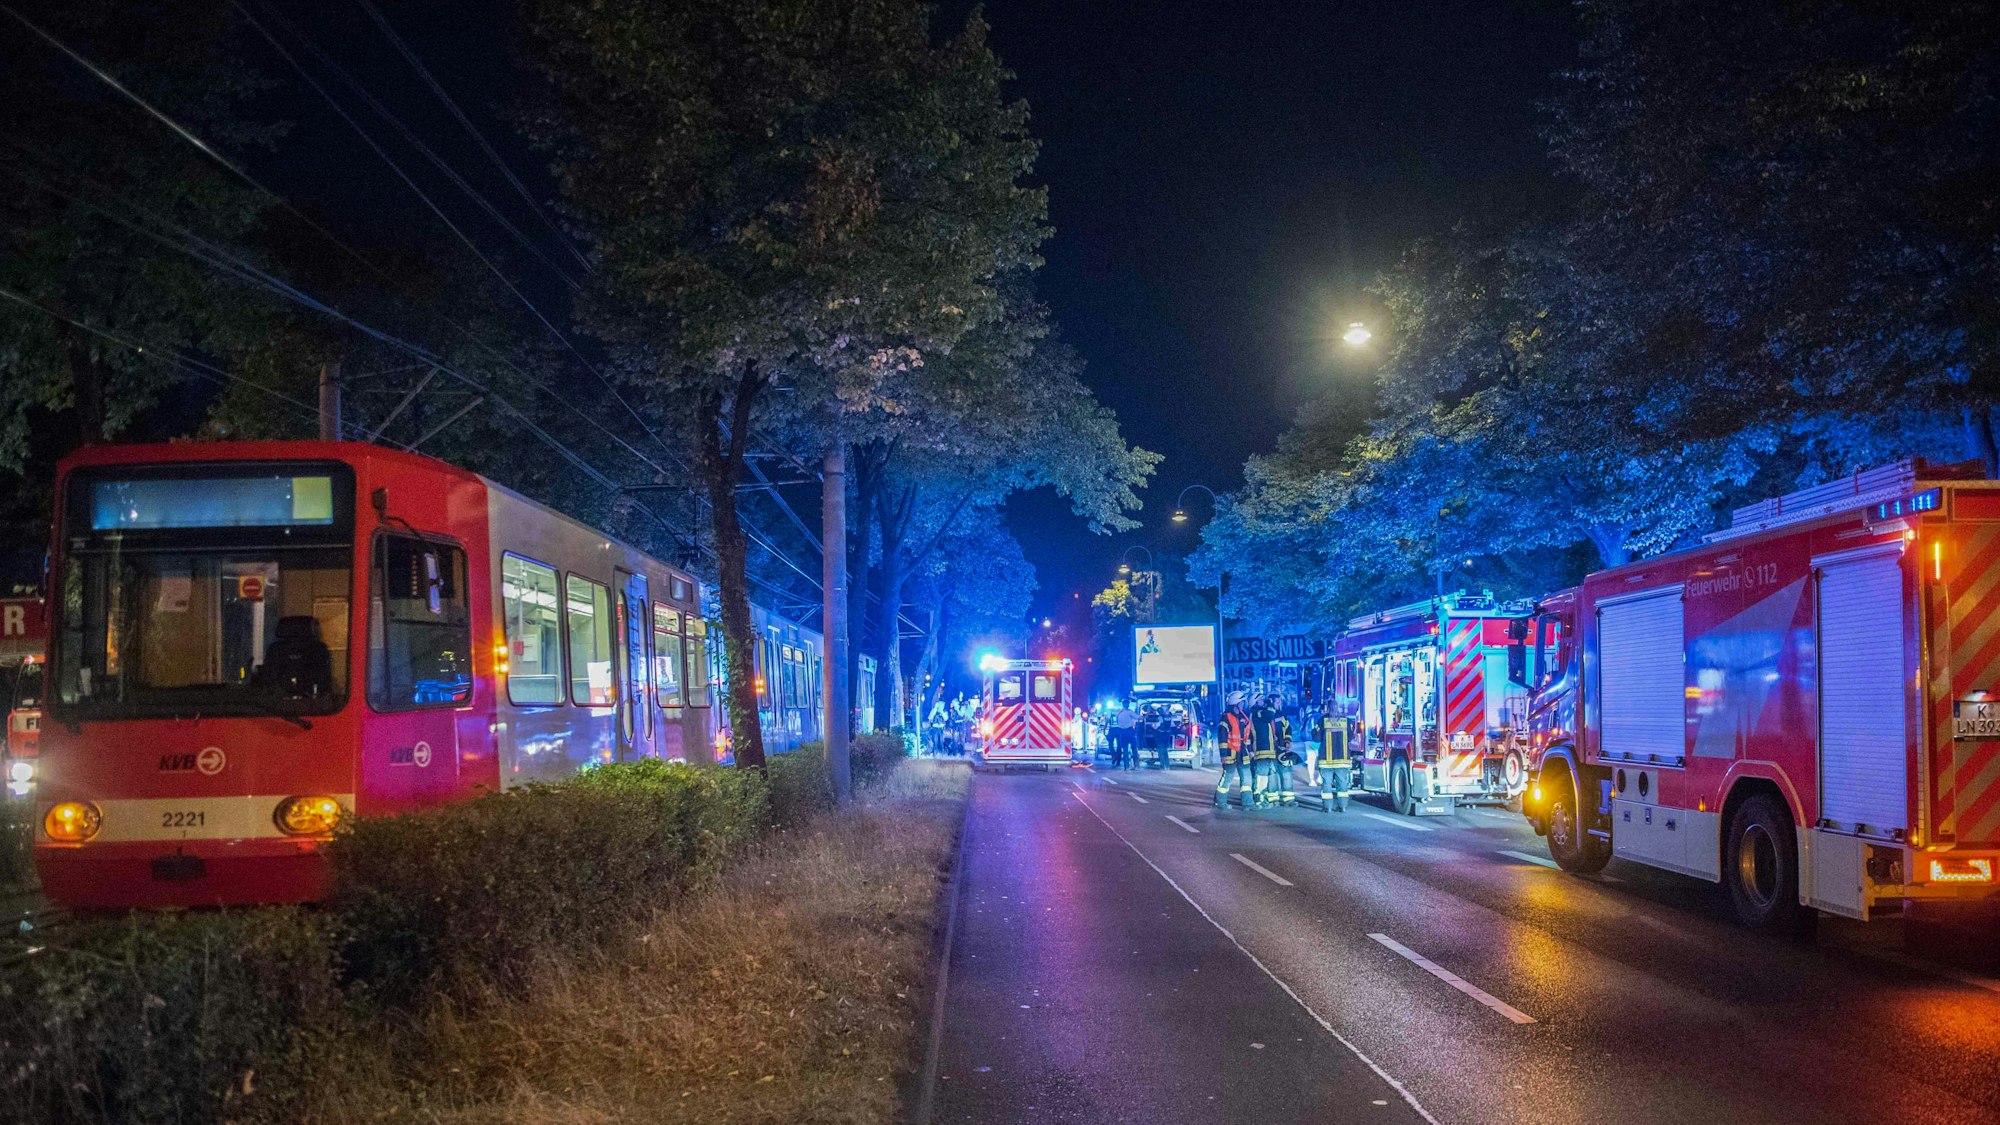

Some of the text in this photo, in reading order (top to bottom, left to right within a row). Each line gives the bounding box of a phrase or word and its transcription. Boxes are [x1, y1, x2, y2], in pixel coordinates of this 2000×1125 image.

[1686, 562, 1777, 598] Feuerwehr 112
[4, 606, 26, 636] R
[1225, 638, 1315, 661] ASSISMUS
[1978, 705, 1987, 719] K
[1957, 720, 1975, 733] LN
[160, 753, 196, 770] KVB
[162, 811, 205, 828] 2221
